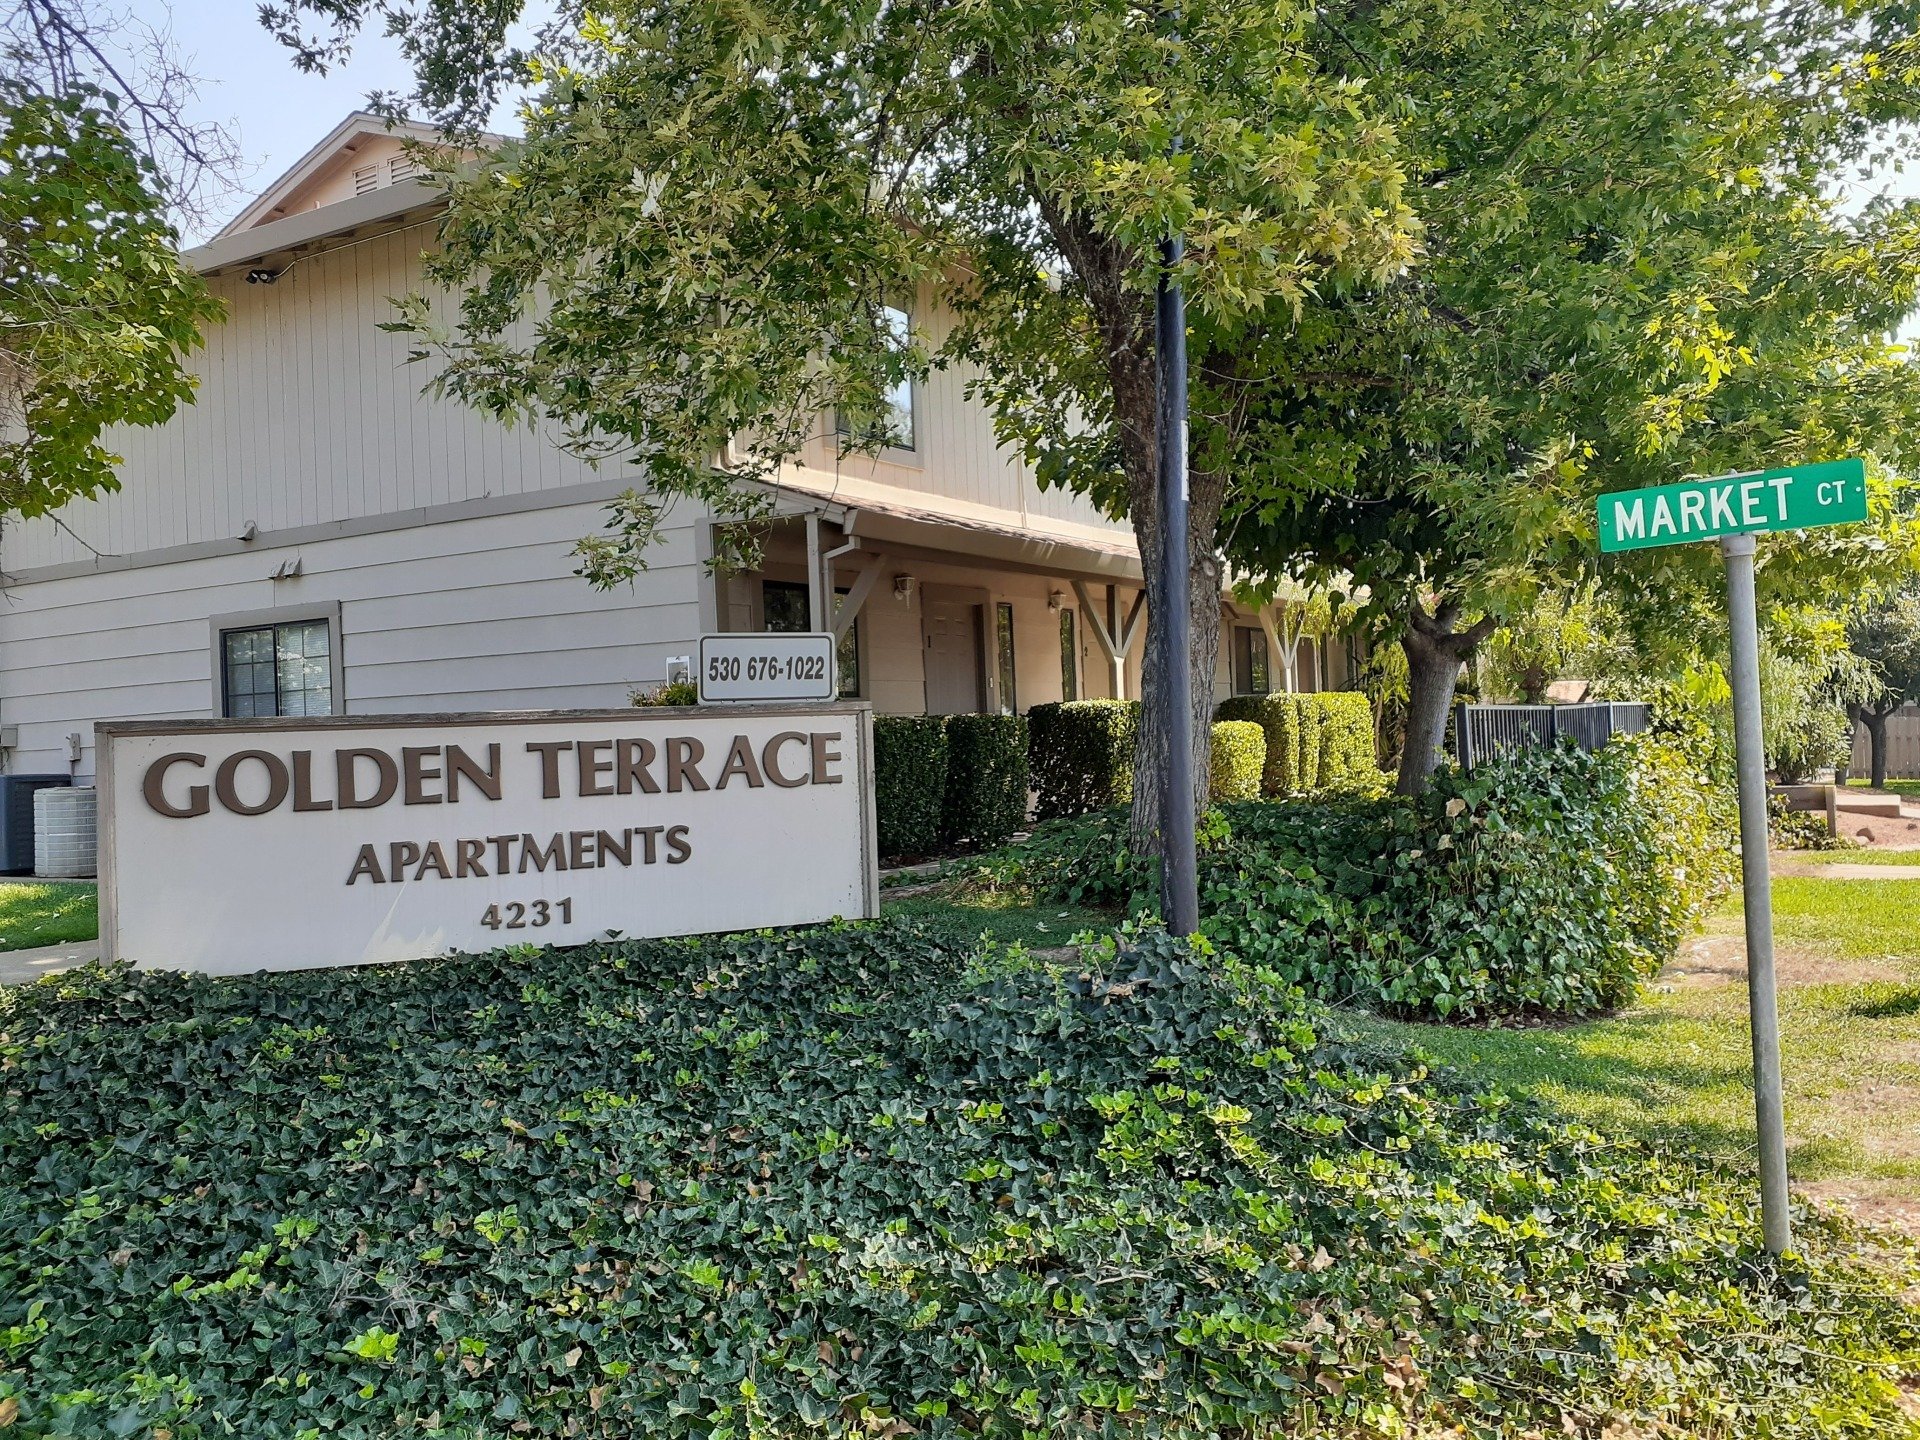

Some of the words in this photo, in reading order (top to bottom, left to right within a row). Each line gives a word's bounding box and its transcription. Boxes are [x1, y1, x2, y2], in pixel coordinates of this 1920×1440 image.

[1614, 476, 1794, 542] MARKET
[1816, 480, 1847, 506] CT
[708, 656, 741, 682] 530
[747, 655, 825, 681] 676-1022
[143, 742, 502, 818] GOLDEN
[525, 731, 843, 799] TERRACE
[345, 824, 693, 886] APARTMENTS
[480, 896, 573, 931] 4231
